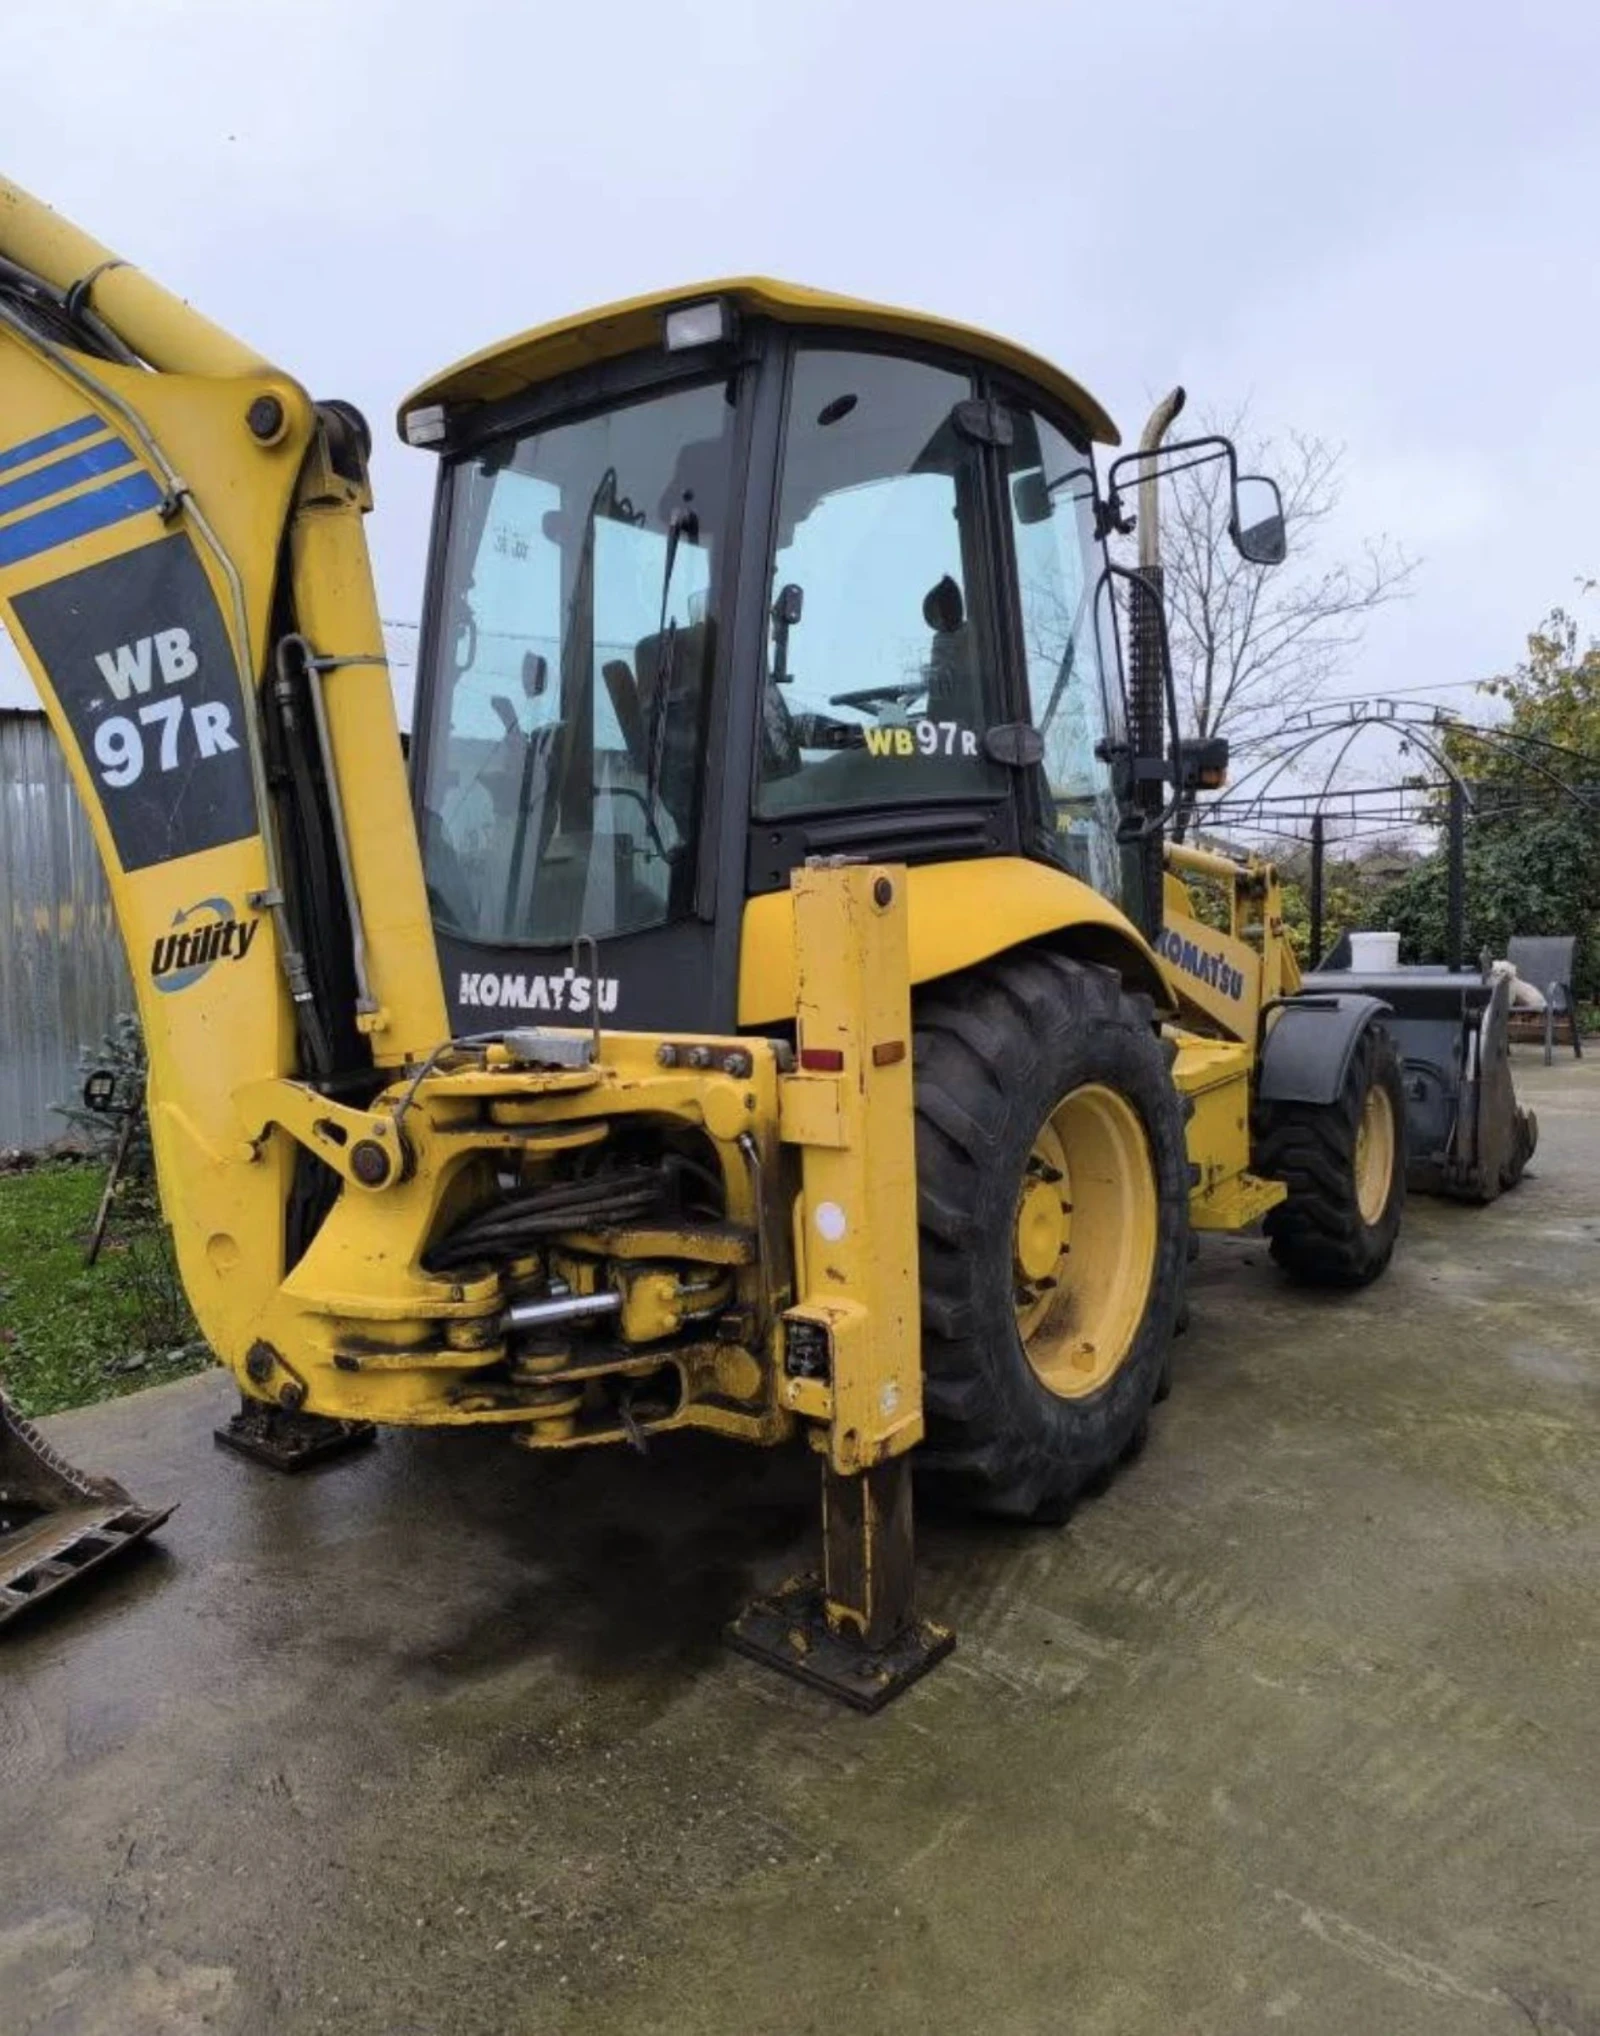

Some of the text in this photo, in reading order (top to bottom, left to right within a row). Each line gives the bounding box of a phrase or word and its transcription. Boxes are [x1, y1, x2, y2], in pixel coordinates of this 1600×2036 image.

[95, 628, 198, 700] WB
[94, 695, 240, 788] 97R
[151, 919, 259, 975] Utility
[459, 967, 619, 1012] KOMATSU
